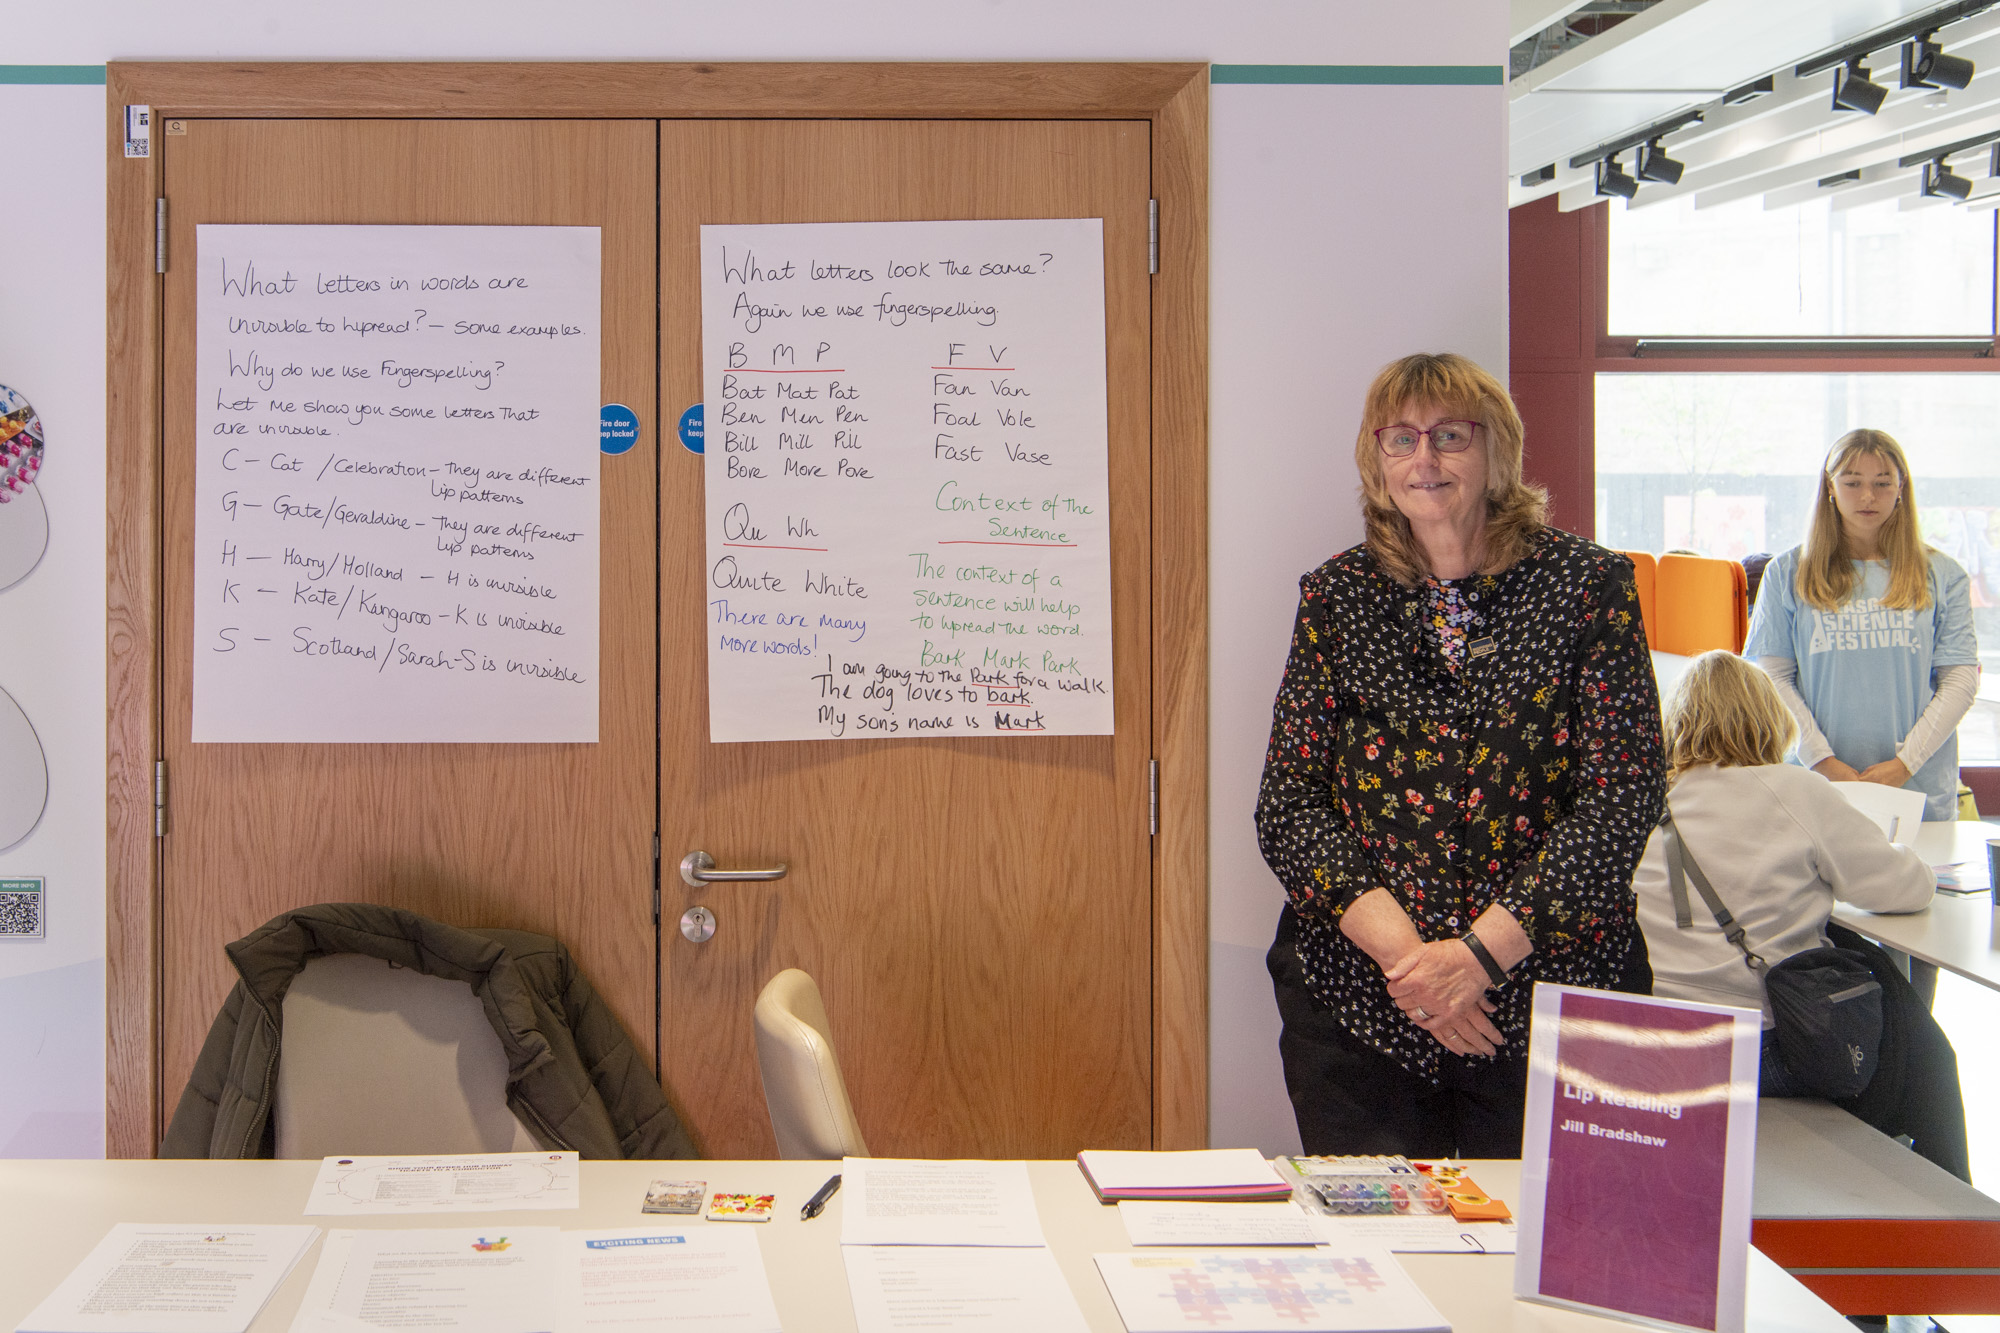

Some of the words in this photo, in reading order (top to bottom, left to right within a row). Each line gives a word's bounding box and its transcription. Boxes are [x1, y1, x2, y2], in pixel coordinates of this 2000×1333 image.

[222, 258, 298, 297] What
[317, 273, 380, 294] letters
[390, 277, 408, 290] in
[421, 275, 479, 290] words
[488, 278, 528, 289] are
[723, 246, 796, 284] What
[811, 259, 874, 281] letters
[888, 260, 930, 278] look
[980, 253, 1053, 276] same?
[316, 317, 335, 332] to
[733, 291, 792, 333] Again
[803, 305, 828, 317] we
[837, 306, 864, 317] use
[729, 342, 747, 368] B
[773, 344, 794, 365] M
[817, 342, 830, 362] P
[949, 343, 966, 365] F
[990, 345, 1007, 363] V
[229, 349, 273, 391] Why
[281, 363, 302, 376] do
[312, 367, 335, 377] we
[343, 366, 371, 378] use
[722, 374, 767, 399] Bat
[777, 382, 819, 399] Mat
[829, 381, 860, 399] Pat
[934, 374, 976, 395] Fan
[991, 379, 1030, 396] Van
[217, 388, 258, 411] Let
[304, 400, 349, 414] show
[348, 405, 384, 425] you
[389, 406, 436, 418] some
[445, 406, 495, 419] letters
[721, 402, 766, 426] Ben
[782, 406, 824, 424] Men
[836, 405, 868, 423] Pen
[934, 403, 981, 426] Foal
[997, 409, 1036, 428] Vole
[213, 423, 249, 435] are
[688, 429, 704, 438] keep
[725, 431, 758, 453] Bill
[779, 433, 813, 450] Mill
[835, 429, 862, 449] Pill
[935, 434, 983, 461] Fast
[1005, 442, 1052, 465] Vase
[222, 448, 239, 470] C
[271, 453, 304, 471] Cat
[486, 471, 513, 480] are
[519, 467, 591, 487] different
[728, 456, 768, 479] Bore
[784, 457, 827, 477] More
[838, 458, 874, 479] Pore
[460, 490, 524, 504] patterns
[936, 480, 1032, 511] Context
[1042, 494, 1058, 520] of
[222, 491, 238, 521] G
[474, 525, 501, 535] are
[506, 523, 584, 543] different
[724, 503, 767, 541] Qu
[788, 516, 819, 537] Wh
[989, 518, 1070, 543] Sentence
[471, 544, 534, 560] patterns
[222, 539, 236, 566] H
[448, 570, 459, 586] H
[469, 574, 479, 587] is
[486, 577, 557, 599] invisible
[713, 555, 786, 592] Quite
[806, 569, 868, 598] White
[909, 553, 945, 579] The
[956, 565, 1018, 584] context
[1022, 568, 1040, 593] of
[1050, 576, 1062, 587] a
[224, 579, 240, 603] K
[456, 604, 468, 625] K
[477, 613, 487, 626] is
[499, 612, 565, 635] invisible
[711, 600, 768, 625] There
[777, 613, 808, 627] are
[1004, 597, 1034, 612] will
[1041, 598, 1080, 619] help
[1822, 609, 1914, 631] SCIENCE
[910, 612, 933, 629] to
[1038, 624, 1084, 635] word.
[764, 637, 817, 657] words!
[1826, 629, 1913, 651] FESTIVAL
[213, 628, 239, 652] S
[482, 655, 496, 671] is
[507, 659, 586, 683] invisible
[921, 640, 965, 668] Bark
[984, 647, 1030, 669] Mark
[1043, 650, 1081, 676] Park
[828, 654, 831, 672] I
[843, 663, 865, 676] am
[875, 664, 911, 687] going
[915, 670, 934, 683] to
[1013, 671, 1036, 686] for
[1037, 679, 1050, 690] a
[811, 674, 852, 699] The
[863, 680, 893, 712] dog
[908, 683, 953, 702] loves
[958, 686, 977, 703] to
[818, 705, 845, 735] My
[909, 717, 954, 730] name
[966, 716, 979, 728] is
[994, 710, 1045, 728] Mark
[1563, 1083, 1595, 1104] Lip
[1600, 1090, 1682, 1120] Reading
[1560, 1118, 1585, 1133] Jill
[1588, 1122, 1667, 1147] Bradshaw
[593, 1239, 644, 1247] EXCITING
